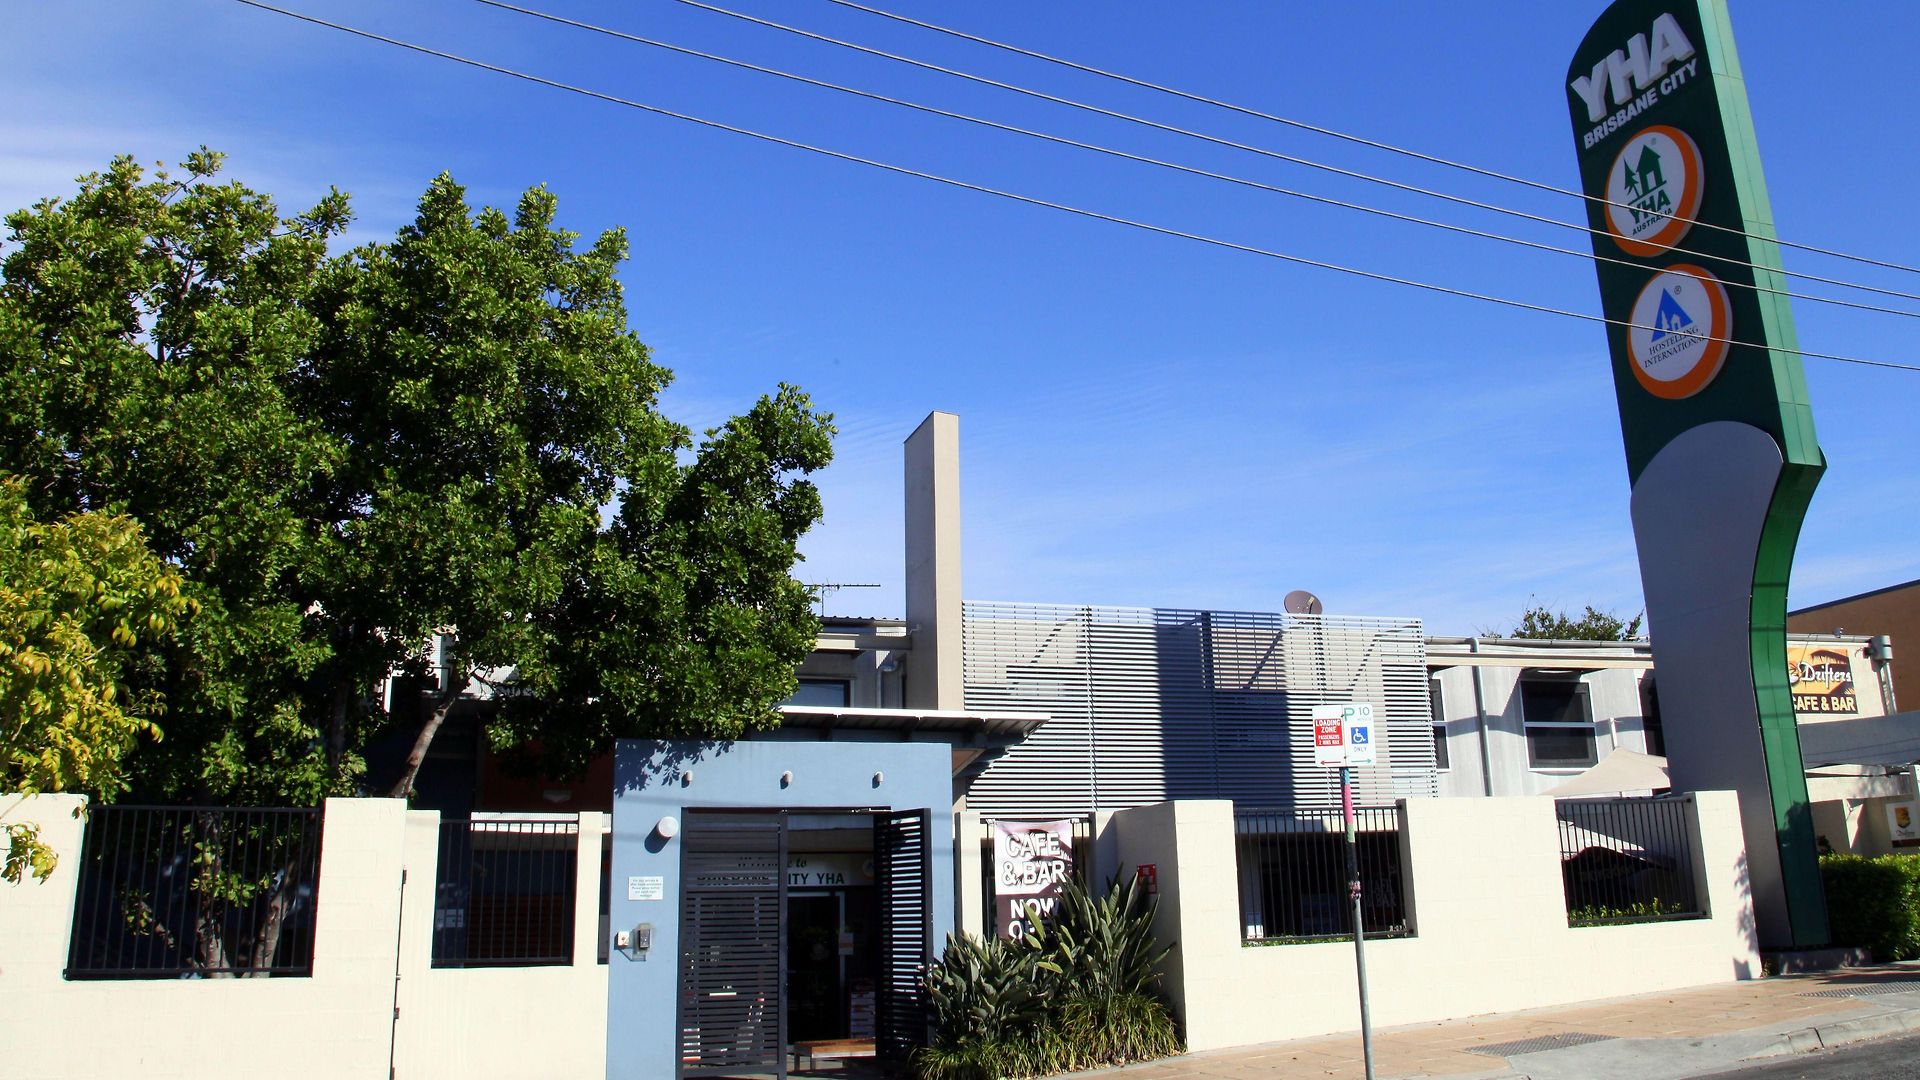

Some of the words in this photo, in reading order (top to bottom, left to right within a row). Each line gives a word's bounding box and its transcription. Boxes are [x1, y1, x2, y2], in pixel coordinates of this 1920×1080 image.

[1570, 12, 1697, 123] YHA
[1583, 87, 1659, 150] BRISBANE
[1660, 58, 1698, 96] CITY
[1629, 189, 1672, 225] YHA
[1797, 661, 1852, 689] Drifters
[1344, 707, 1355, 721] P
[1359, 706, 1370, 716] 10
[1821, 696, 1830, 711] &
[1831, 696, 1856, 711] BAR
[1315, 719, 1341, 727] LOADING
[1321, 726, 1337, 734] ZONE
[1005, 832, 1061, 857] CAFE
[788, 873, 809, 885] ITY
[816, 872, 845, 885] YHA
[1002, 861, 1021, 886] &
[1022, 861, 1067, 885] BAR
[1010, 897, 1060, 919] NOW
